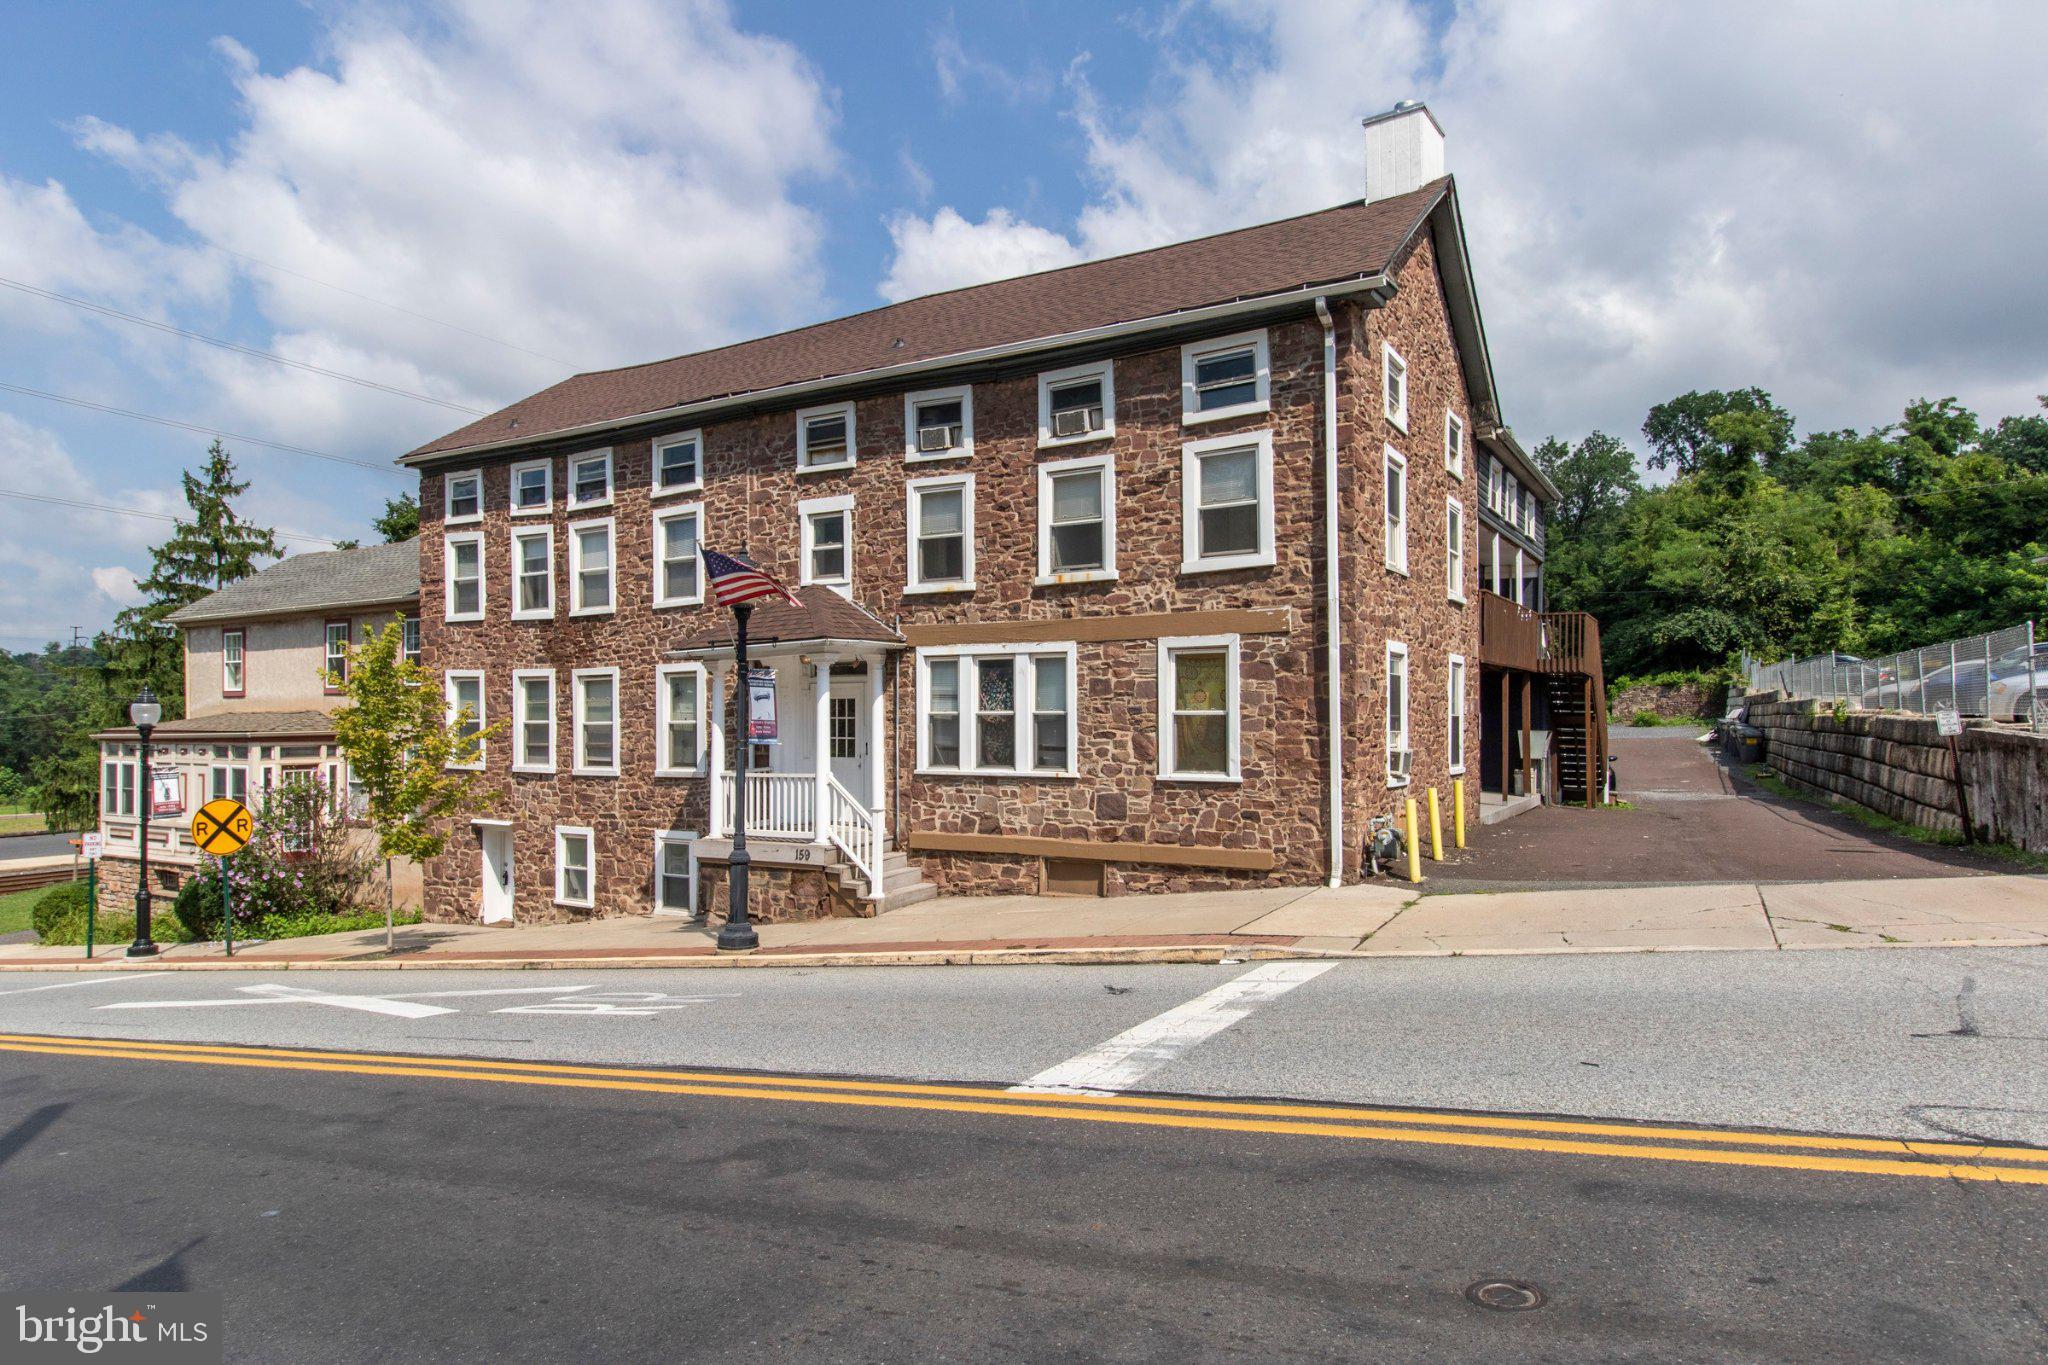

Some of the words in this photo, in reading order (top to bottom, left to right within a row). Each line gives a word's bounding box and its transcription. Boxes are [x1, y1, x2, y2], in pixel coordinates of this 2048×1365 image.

[197, 822, 208, 836] R
[237, 818, 248, 832] R
[795, 848, 811, 861] 159
